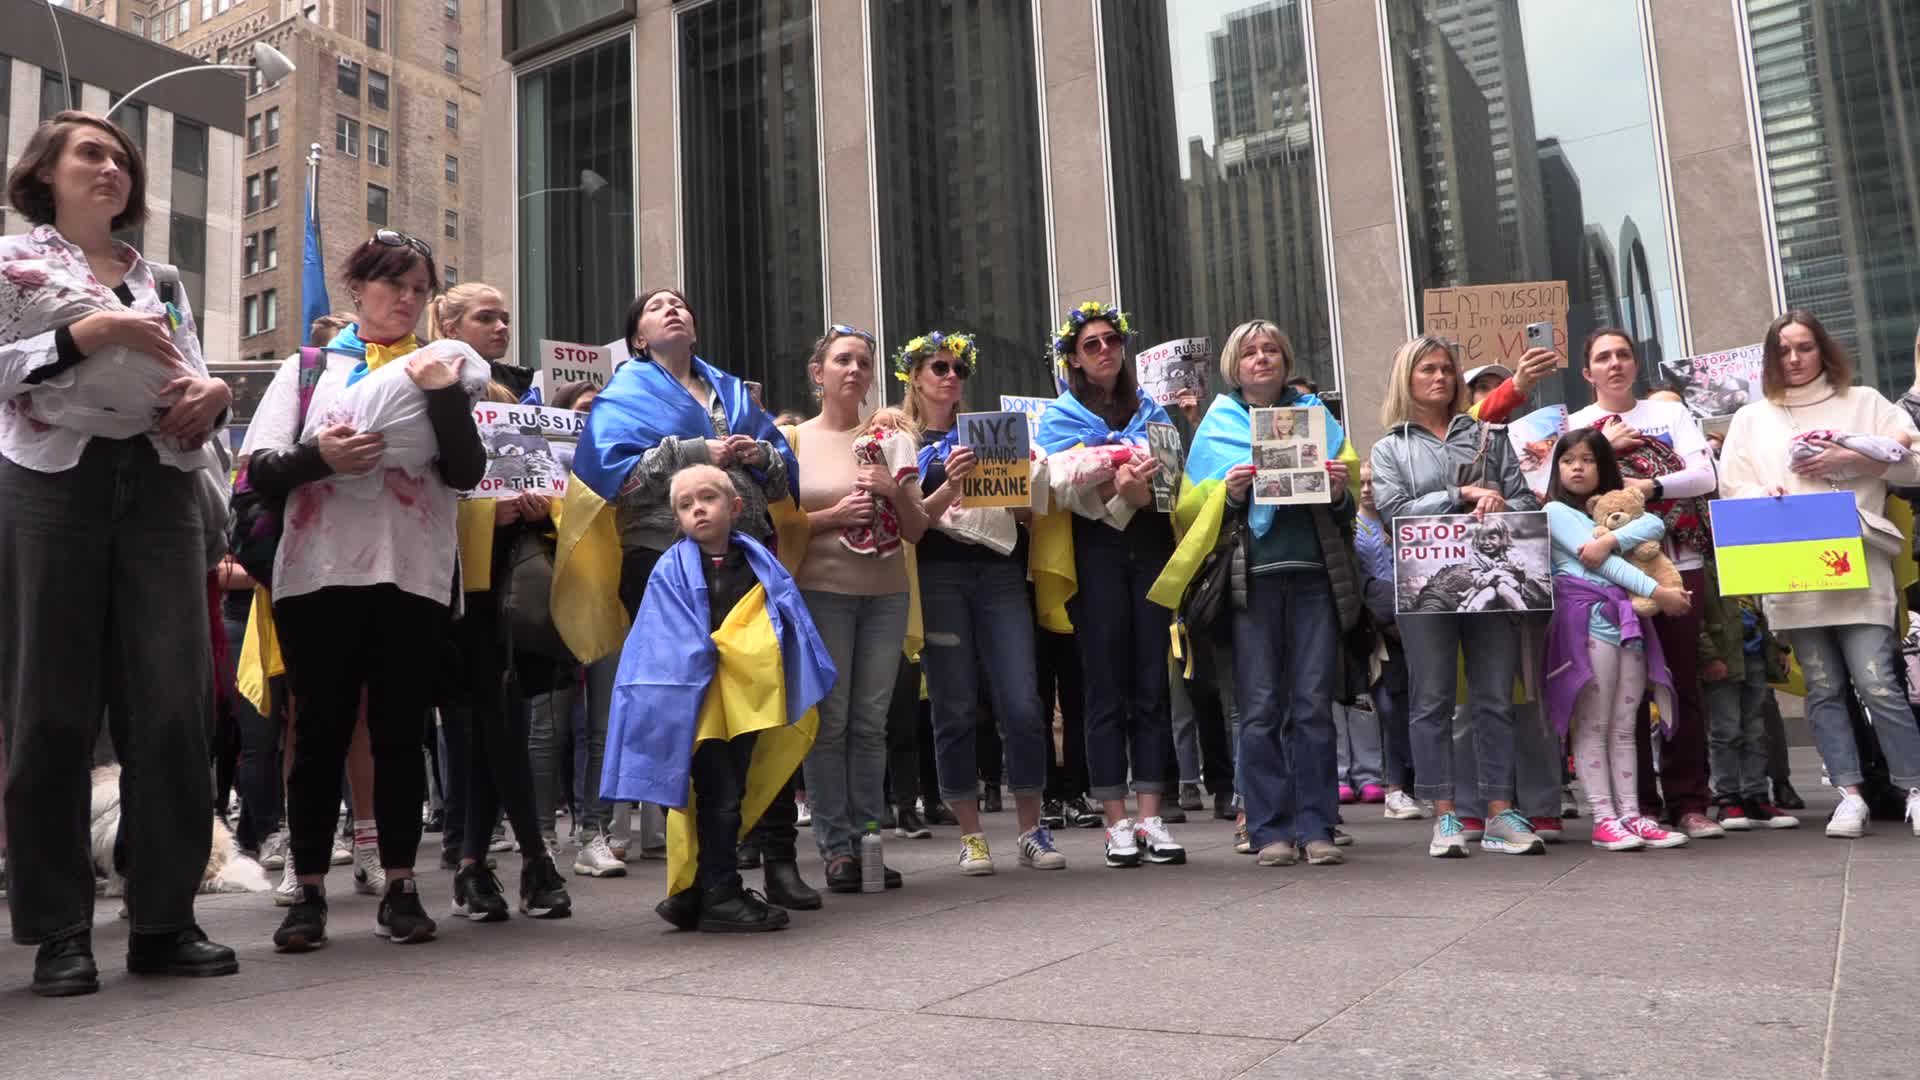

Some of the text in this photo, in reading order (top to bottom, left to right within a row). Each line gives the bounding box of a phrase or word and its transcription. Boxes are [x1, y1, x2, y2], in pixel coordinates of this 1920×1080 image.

[1428, 316, 1458, 330] and
[1498, 328, 1567, 360] WR
[553, 347, 599, 364] STOP
[1141, 349, 1169, 367] STOP
[1695, 354, 1727, 368] STOP
[552, 367, 604, 385] PUTIN
[509, 412, 584, 432] RUSSIA
[968, 417, 1017, 445] NYC
[983, 467, 1008, 476] WITH
[512, 477, 546, 488] THE
[963, 476, 1028, 497] UKRAINE
[1401, 525, 1466, 541] STOP
[1402, 546, 1466, 560] PUTIN
